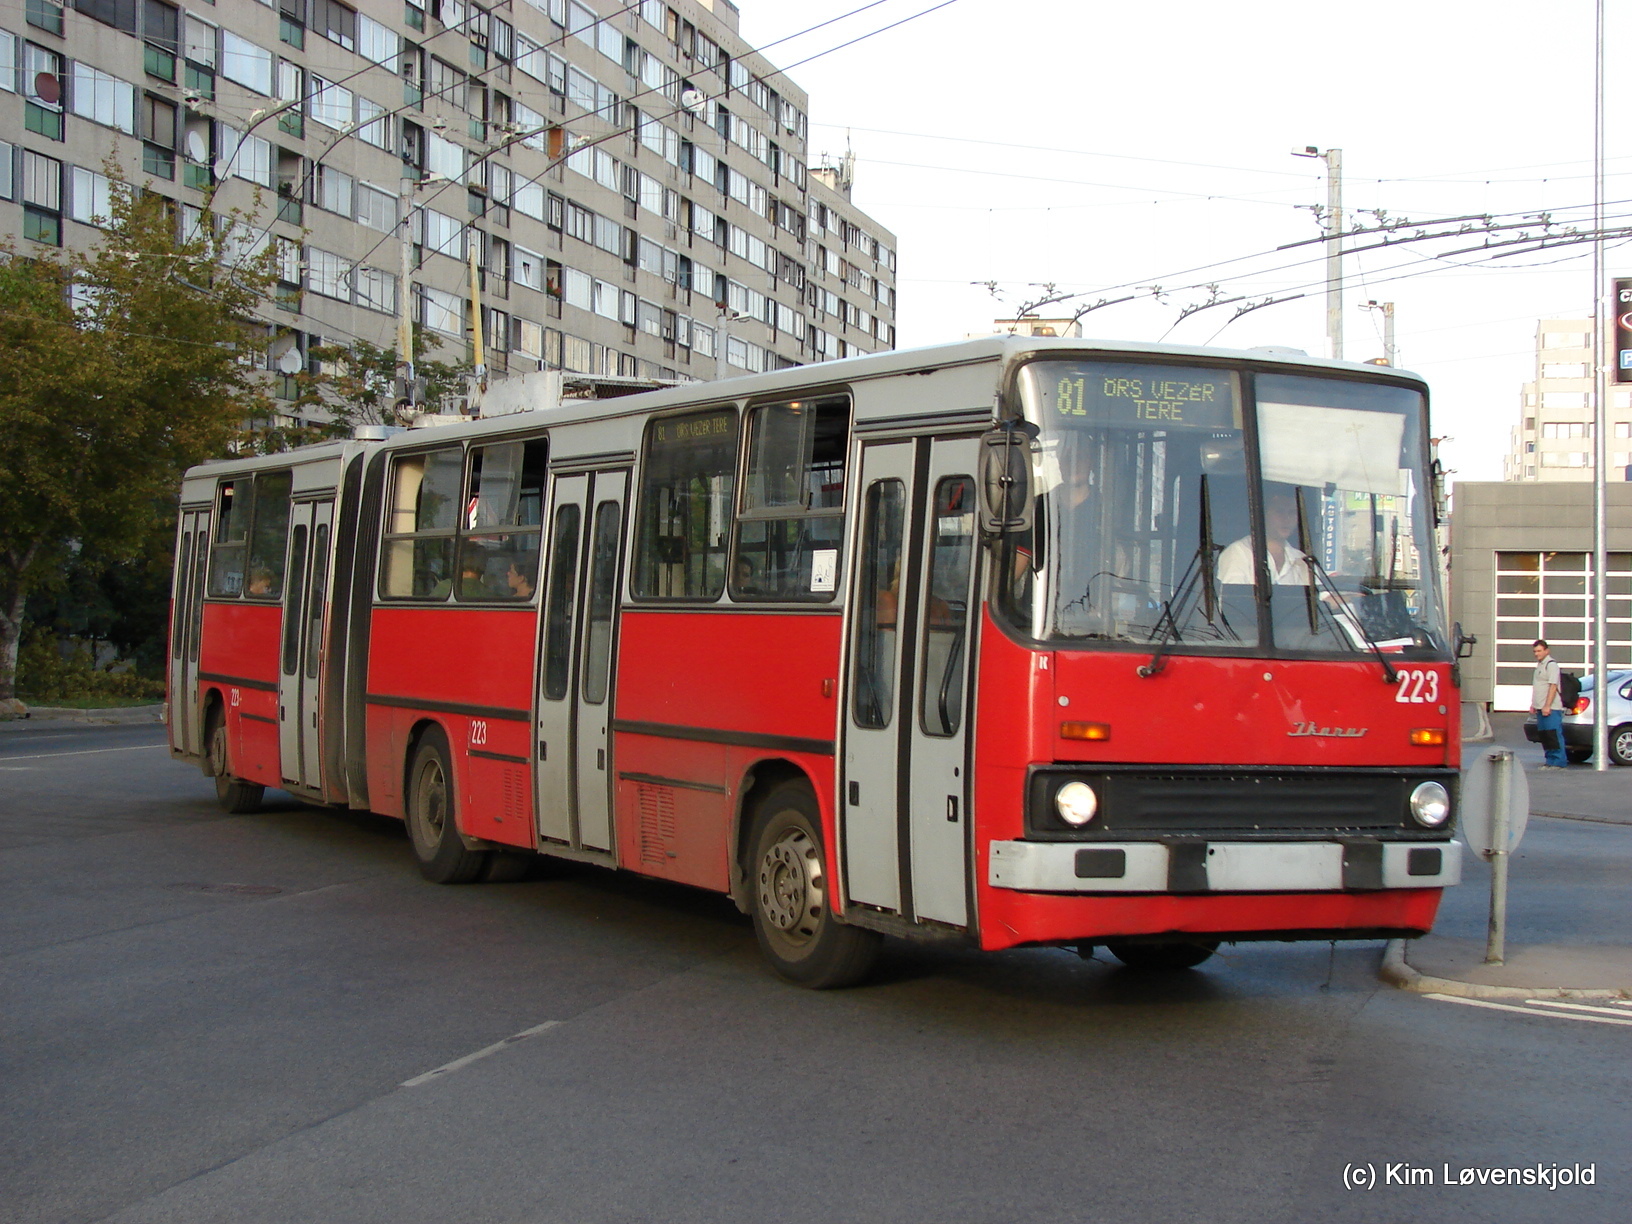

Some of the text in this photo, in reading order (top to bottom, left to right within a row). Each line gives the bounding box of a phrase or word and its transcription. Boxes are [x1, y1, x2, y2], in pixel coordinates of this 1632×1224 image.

[1057, 377, 1087, 416] 81
[1103, 377, 1215, 401] ÖRS VEZÉR
[1133, 400, 1184, 421] TERE
[713, 416, 728, 433] TERE
[231, 688, 240, 707] 223
[1395, 669, 1439, 704] 223
[471, 720, 488, 745] 223
[1287, 721, 1368, 737] Ikarus
